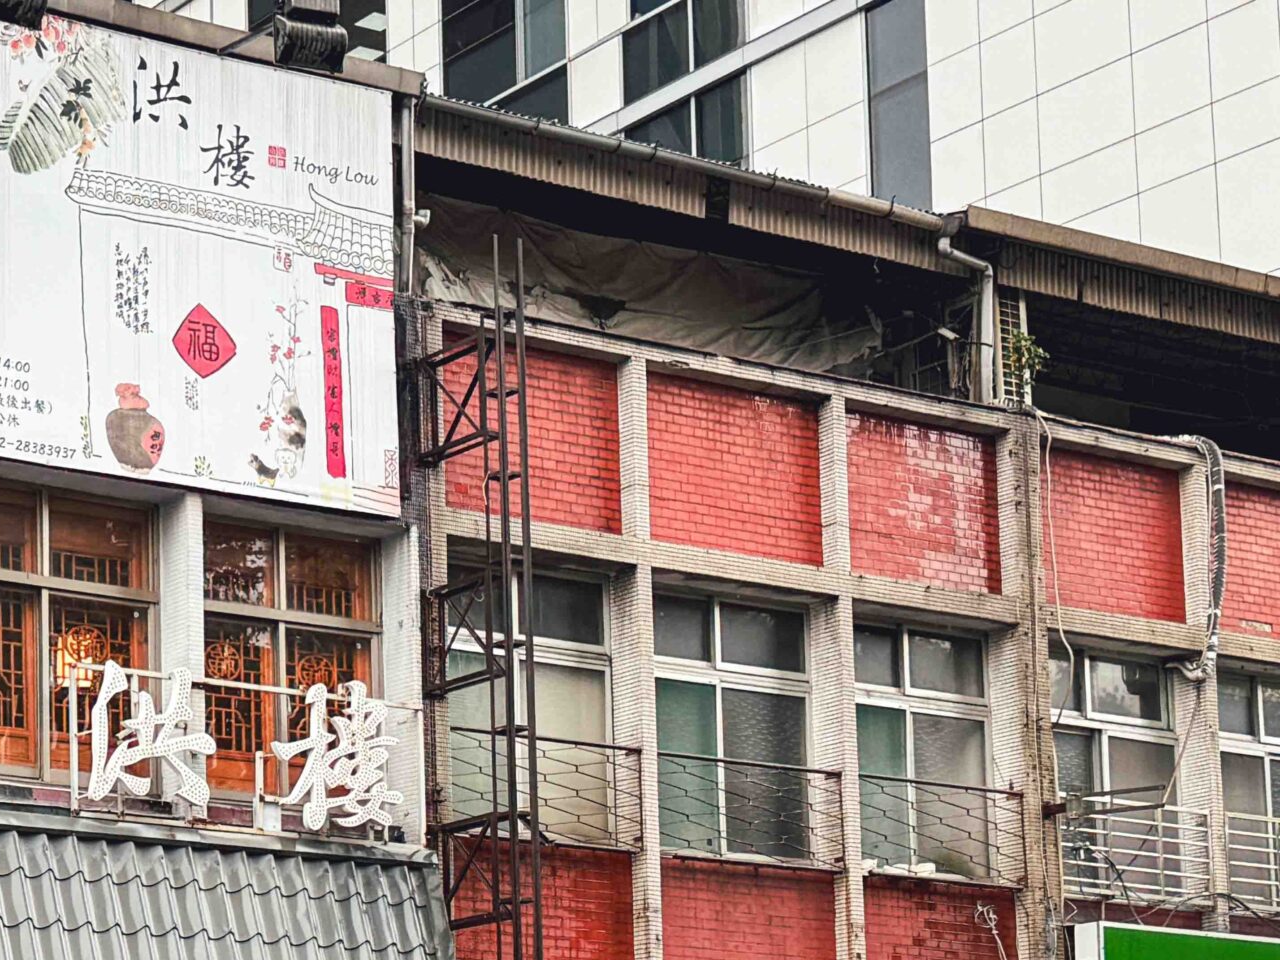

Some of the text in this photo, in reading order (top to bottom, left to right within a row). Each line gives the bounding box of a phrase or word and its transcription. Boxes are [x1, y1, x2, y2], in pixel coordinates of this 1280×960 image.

[293, 156, 342, 183] Hong
[345, 165, 380, 186] Lou
[187, 319, 220, 362] 福
